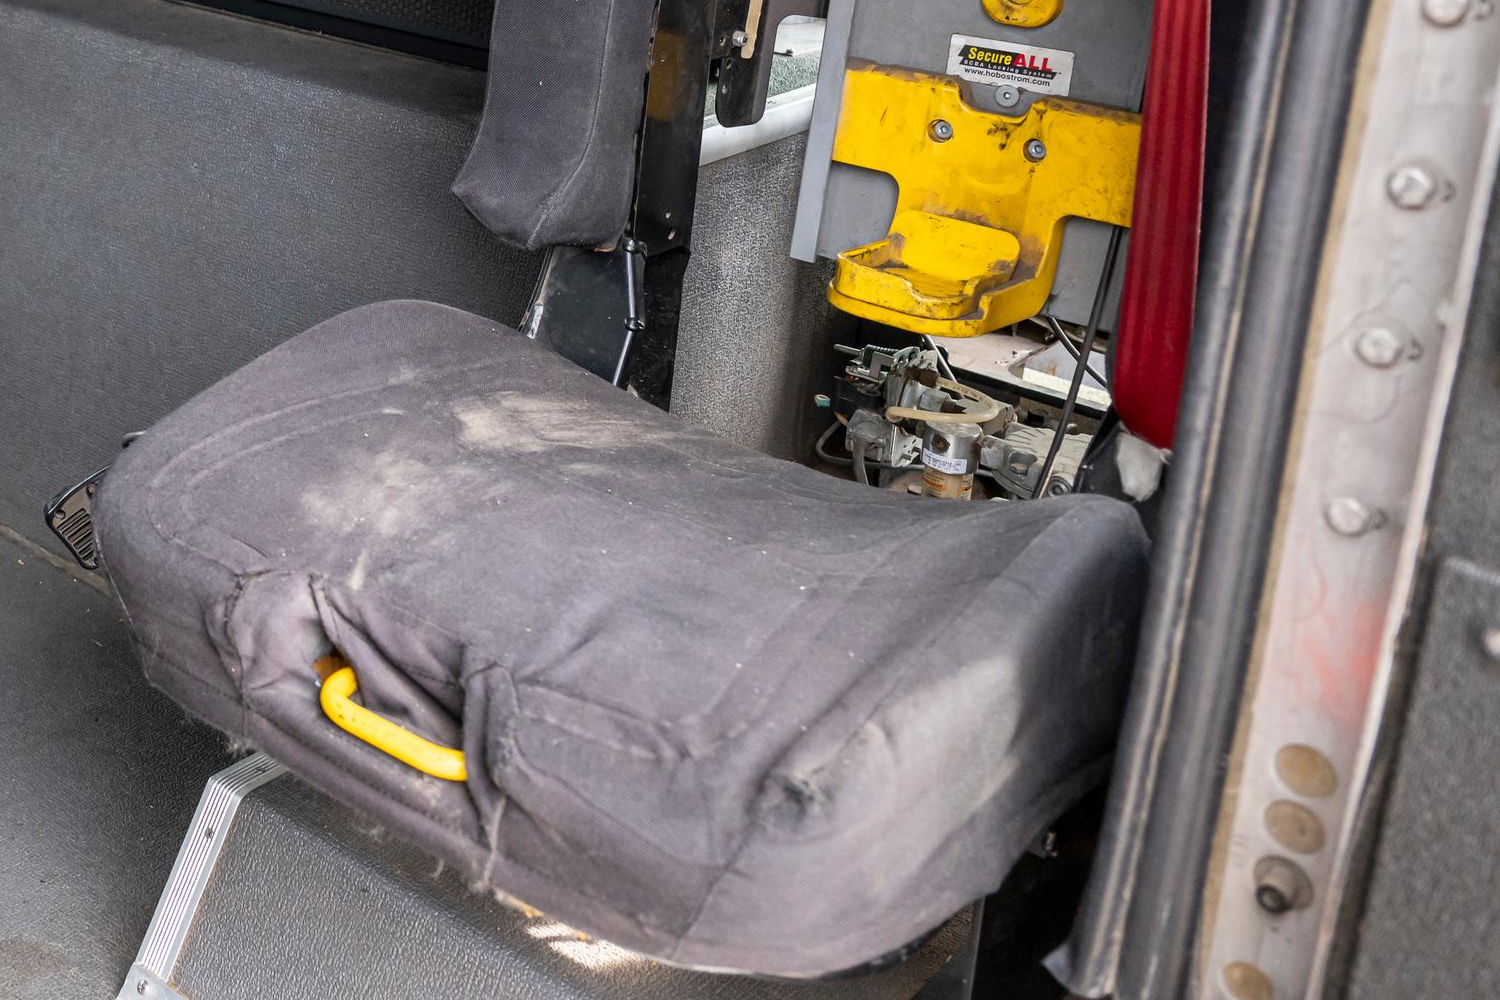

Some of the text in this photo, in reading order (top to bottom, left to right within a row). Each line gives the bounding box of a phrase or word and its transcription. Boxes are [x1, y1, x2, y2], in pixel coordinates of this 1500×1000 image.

[964, 59, 984, 68] SCBA
[987, 63, 1020, 74] Locking
[968, 46, 1053, 73] SecureALL
[964, 67, 1051, 87] www.hobostrom.com
